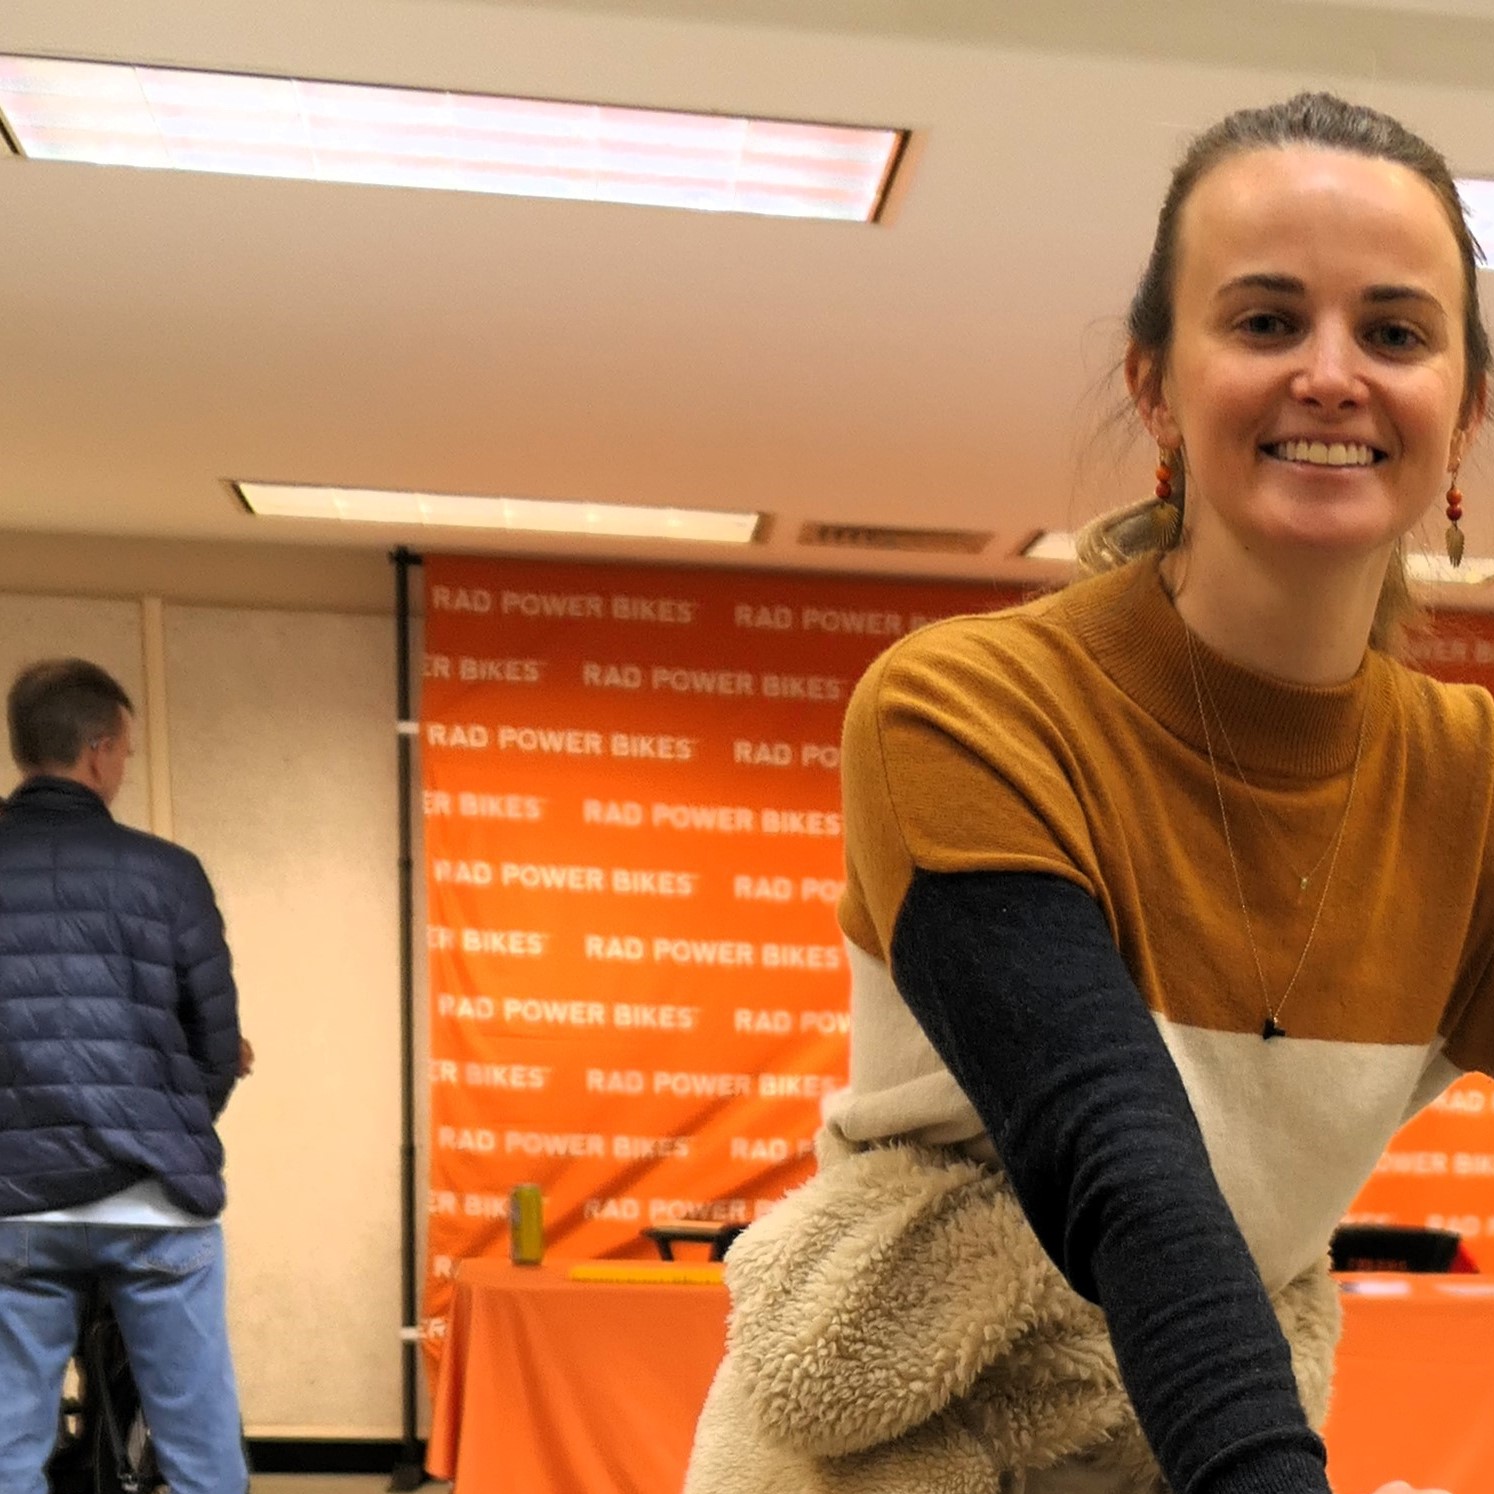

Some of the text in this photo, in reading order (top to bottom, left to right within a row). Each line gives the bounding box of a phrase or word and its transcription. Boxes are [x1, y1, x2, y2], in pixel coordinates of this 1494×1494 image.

[432, 585, 692, 623] RAD POWER BIKES
[734, 604, 793, 629] RAD
[802, 607, 901, 635] POWER
[459, 656, 538, 681] BIKES
[583, 662, 840, 700] RAD POWER BIKES
[427, 723, 692, 761] RAD POWER BIKES
[733, 739, 793, 767] RAD
[459, 792, 541, 819] BIKES
[583, 798, 841, 836] RAD POWER BIKES
[433, 859, 694, 895] RAD POWER BIKES
[733, 874, 793, 901] RAD
[462, 928, 543, 955] BIKES
[585, 934, 840, 969] RAD POWER BIKES
[437, 994, 695, 1029] RAD POWER BIKES
[734, 1008, 792, 1033] RAD
[465, 1063, 544, 1089] BIKES
[586, 1068, 838, 1098] RAD POWER BIKES
[439, 1126, 689, 1158] RAD POWER BIKES
[730, 1137, 788, 1160] RAD
